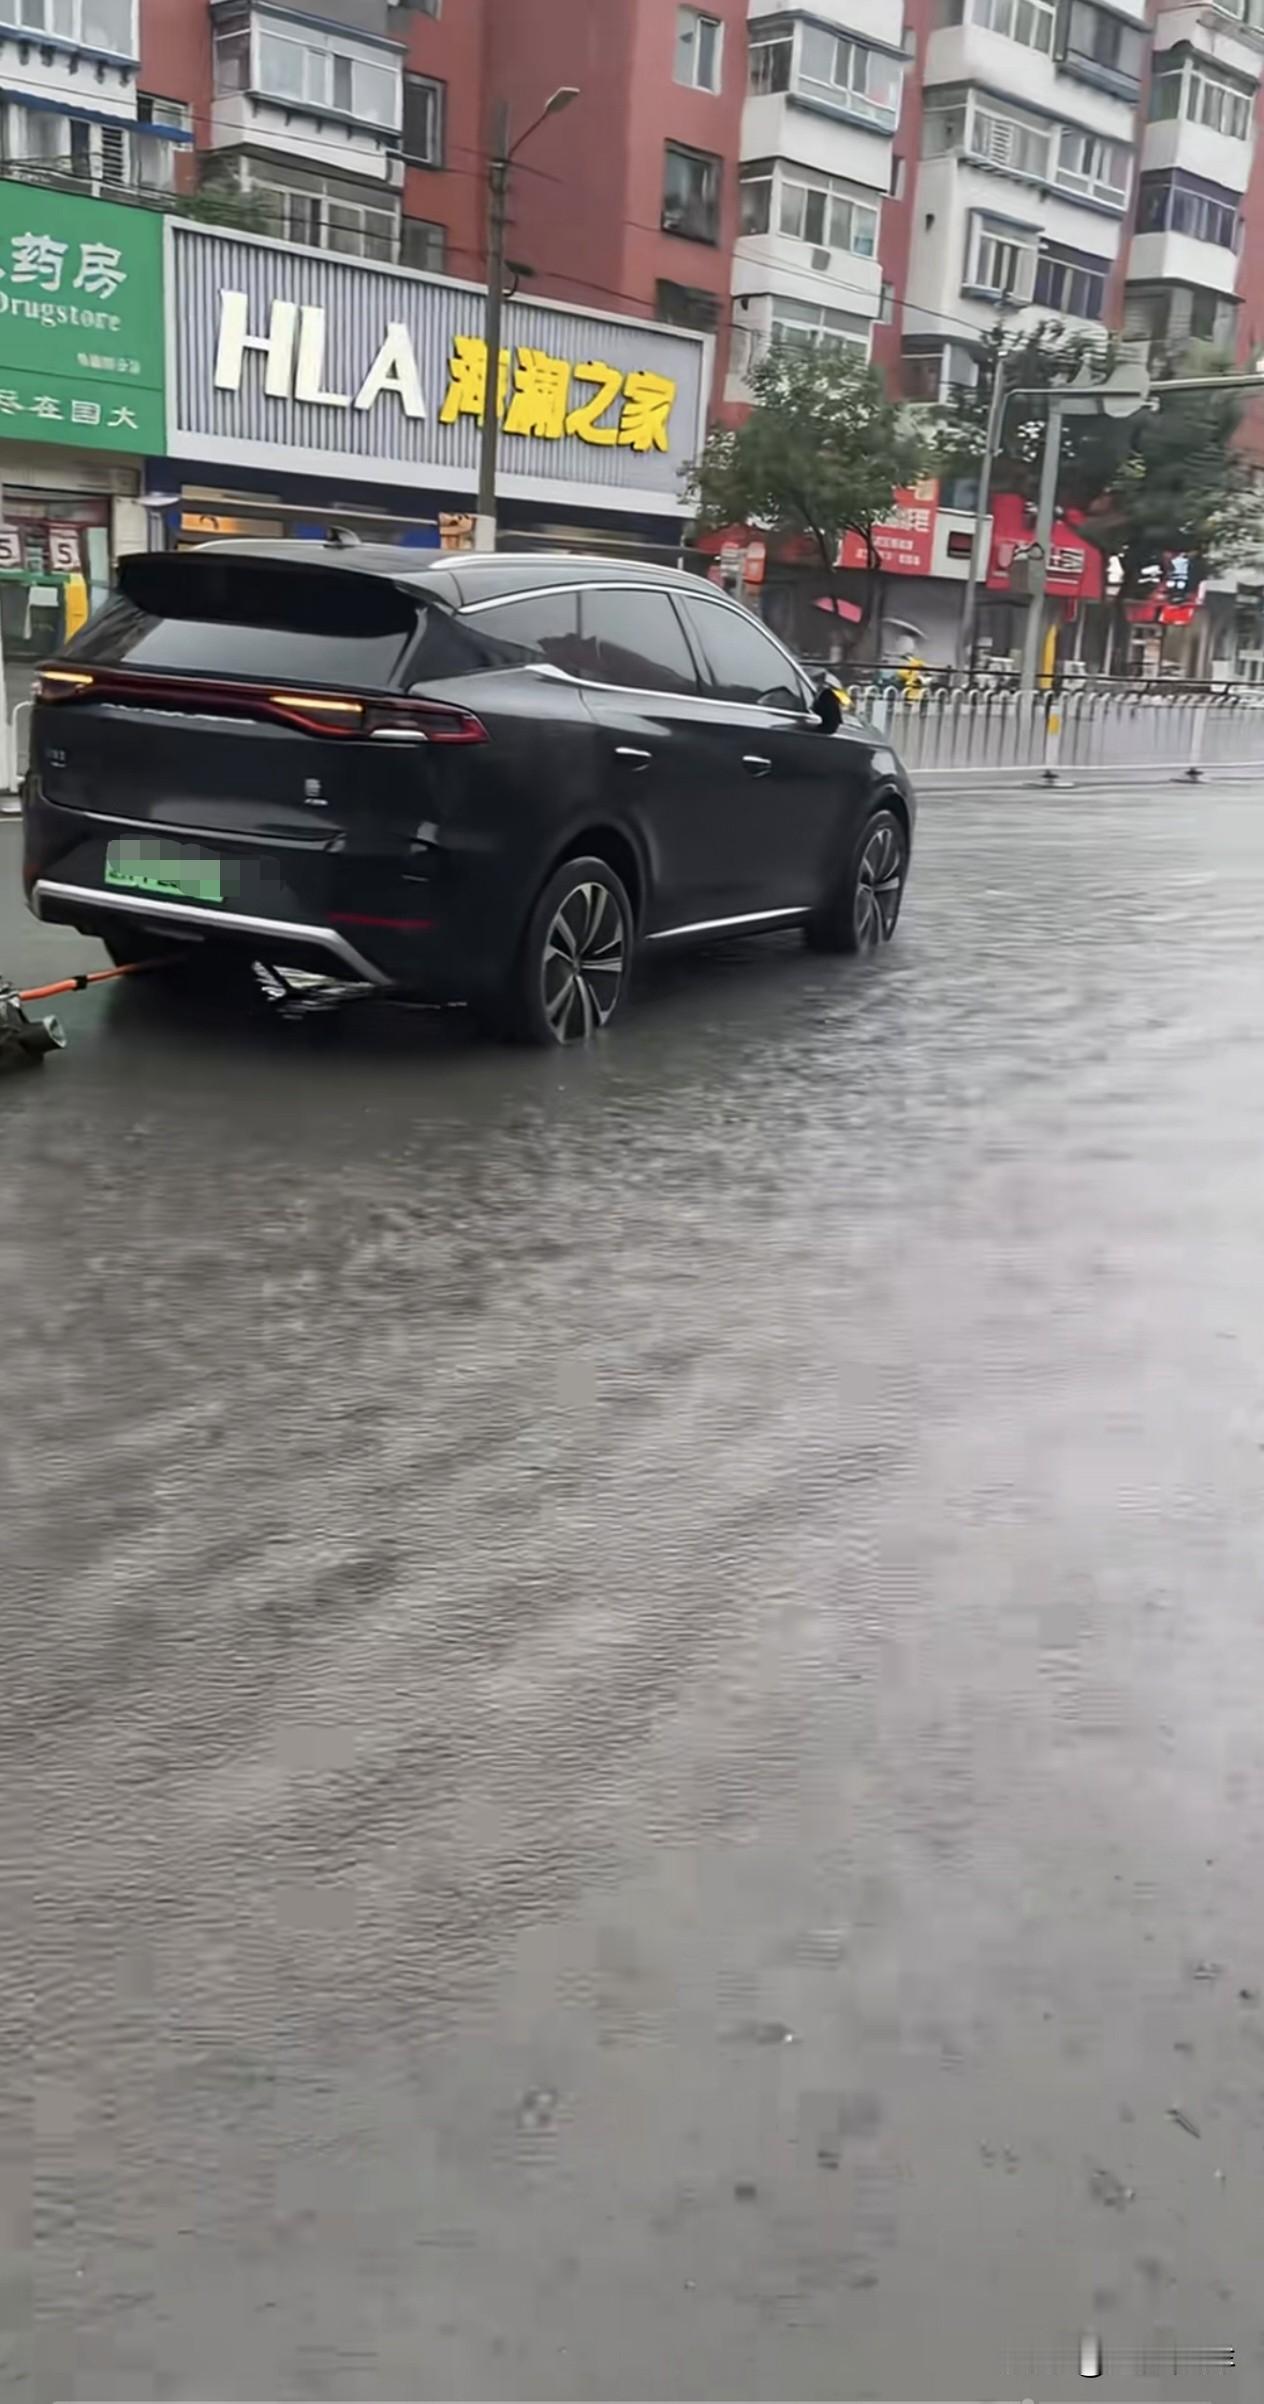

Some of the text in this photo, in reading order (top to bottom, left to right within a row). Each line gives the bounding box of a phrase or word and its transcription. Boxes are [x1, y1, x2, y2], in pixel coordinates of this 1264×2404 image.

[0, 232, 127, 299] 药房
[214, 289, 426, 419] HLA
[440, 335, 676, 453] 海澜之家
